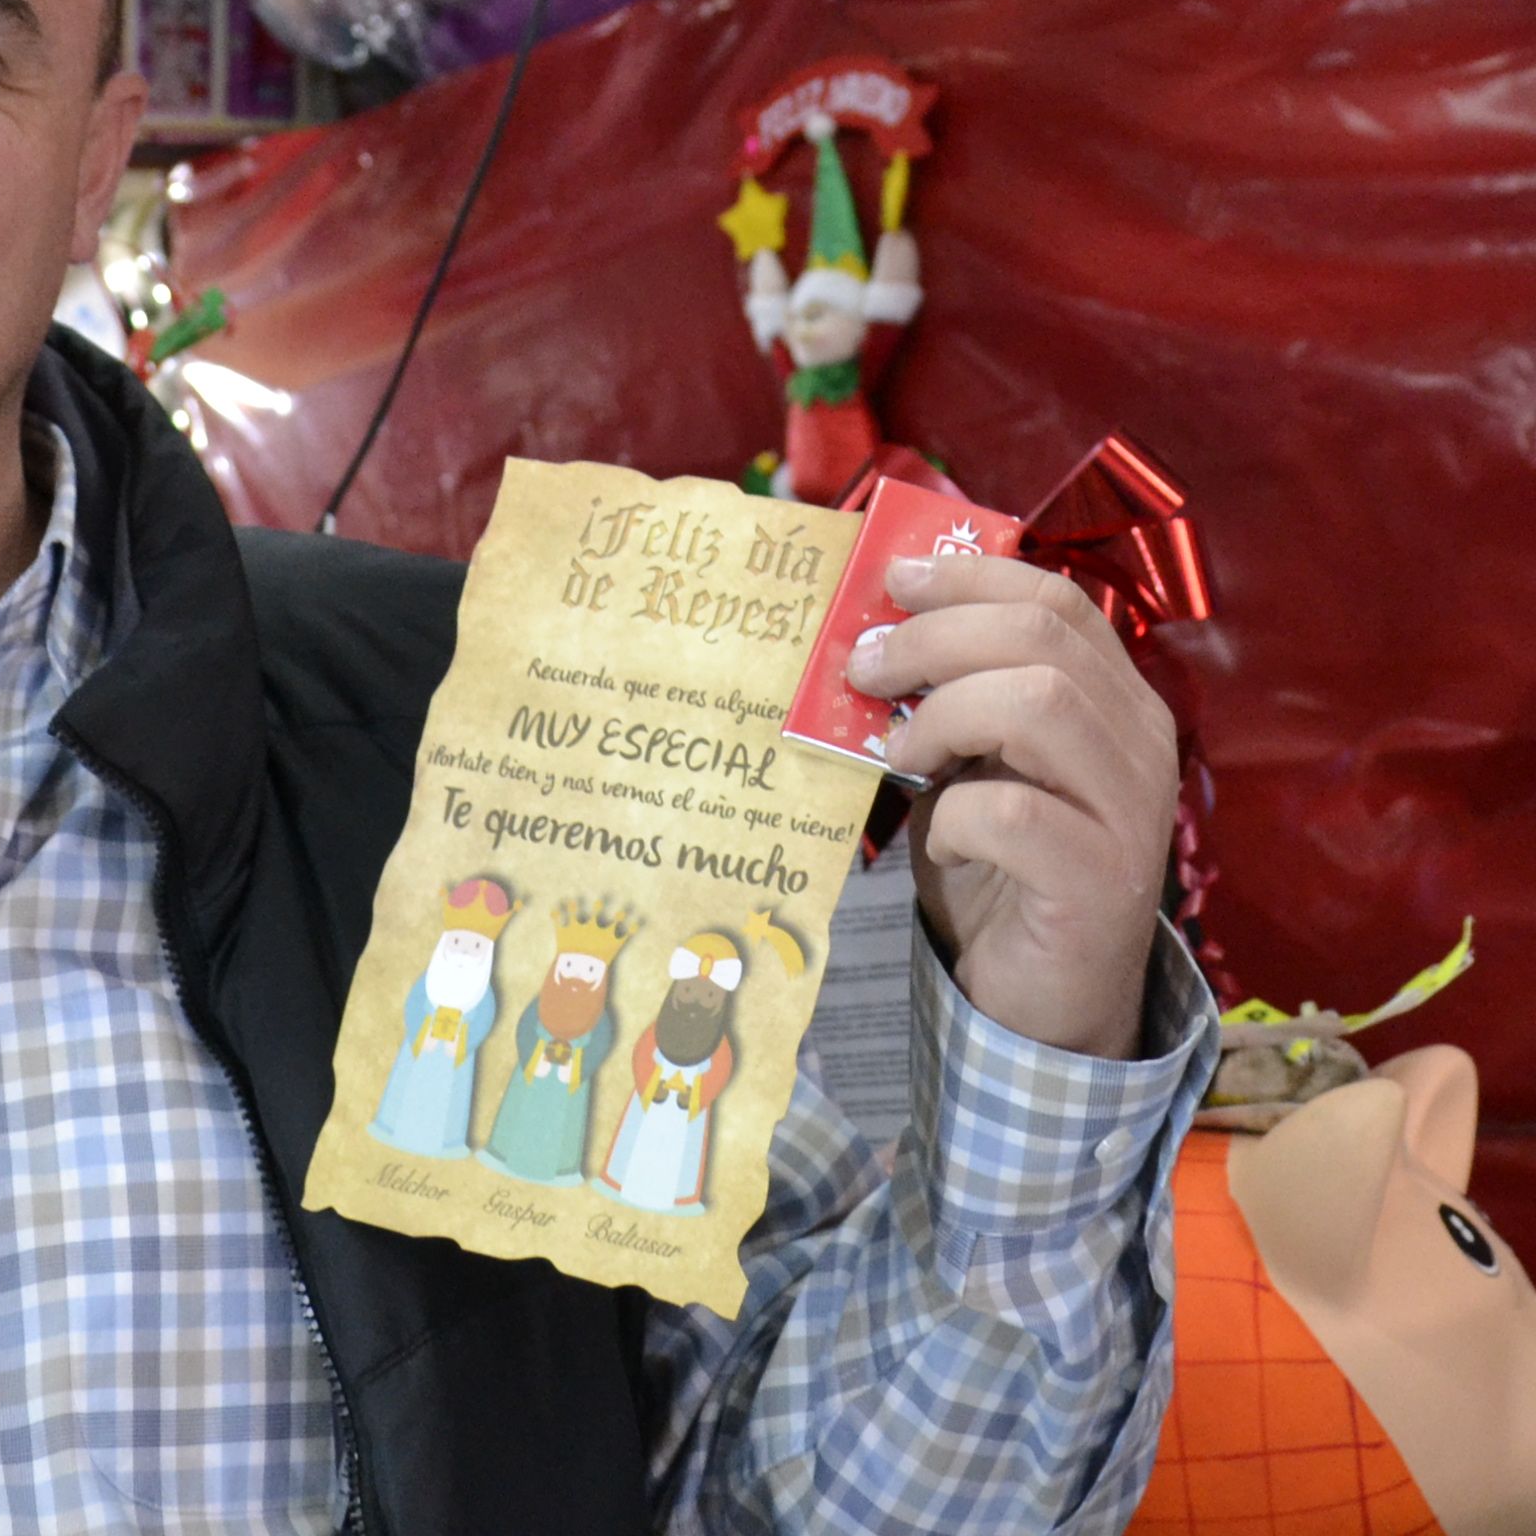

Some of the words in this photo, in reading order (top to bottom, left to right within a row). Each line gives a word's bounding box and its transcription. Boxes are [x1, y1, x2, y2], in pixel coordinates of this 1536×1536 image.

[745, 524, 825, 586] día
[562, 558, 615, 612] de
[630, 565, 816, 647] Reyes!
[527, 657, 615, 692] Recuerda
[623, 676, 661, 704] que
[666, 685, 707, 708] eres
[507, 704, 592, 750] MUY
[597, 717, 776, 791] ESPECIAL
[498, 755, 539, 785] bien
[541, 772, 557, 795] y
[563, 773, 594, 794] nos
[602, 782, 664, 809] vemos
[671, 787, 695, 813] el
[699, 794, 736, 820] año
[743, 805, 783, 832] que
[790, 813, 855, 844] viene!
[442, 786, 472, 829] Te
[484, 804, 663, 868] queremos
[677, 843, 809, 895] mucho
[366, 1162, 451, 1202] Melchor
[482, 1185, 557, 1230] Gaspar
[583, 1213, 683, 1261] Baltasar
